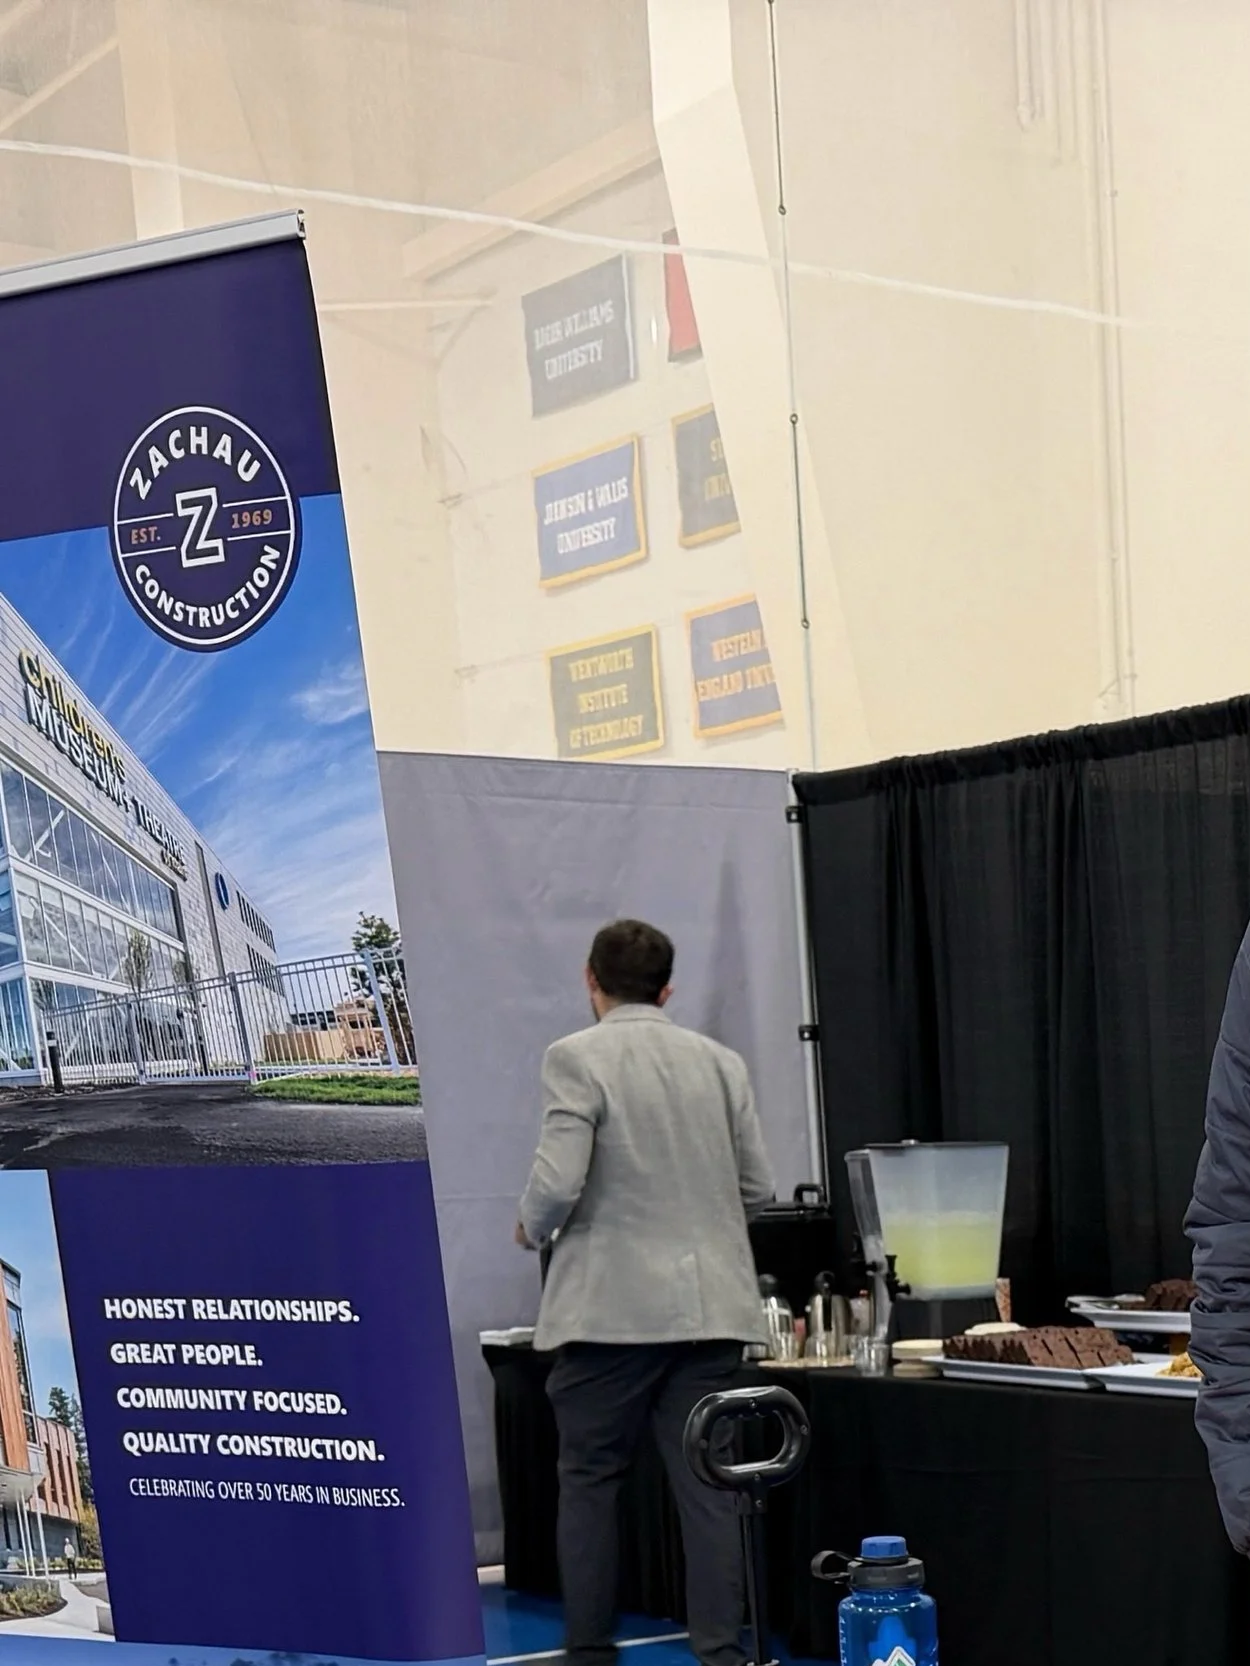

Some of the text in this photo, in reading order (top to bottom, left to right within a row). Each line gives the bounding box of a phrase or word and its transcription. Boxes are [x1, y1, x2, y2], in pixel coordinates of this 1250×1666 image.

[129, 426, 261, 500] ZACHAU
[131, 509, 273, 545] EST. 1969
[557, 517, 616, 554] UNIVERSITY
[134, 544, 281, 629] CONSTRUCTION
[25, 682, 123, 808] MUSEUM
[103, 1298, 361, 1323] HONEST RELATIONSHIPS.
[110, 1343, 263, 1367] GREAT PEOPLE.
[116, 1388, 348, 1415] COMMUNITY FOCUSED.
[122, 1432, 386, 1462] QUALITY CONSTRUCTION.
[129, 1478, 406, 1508] CELEBRATING OVER 50 YEARS IN BUSINESS.
